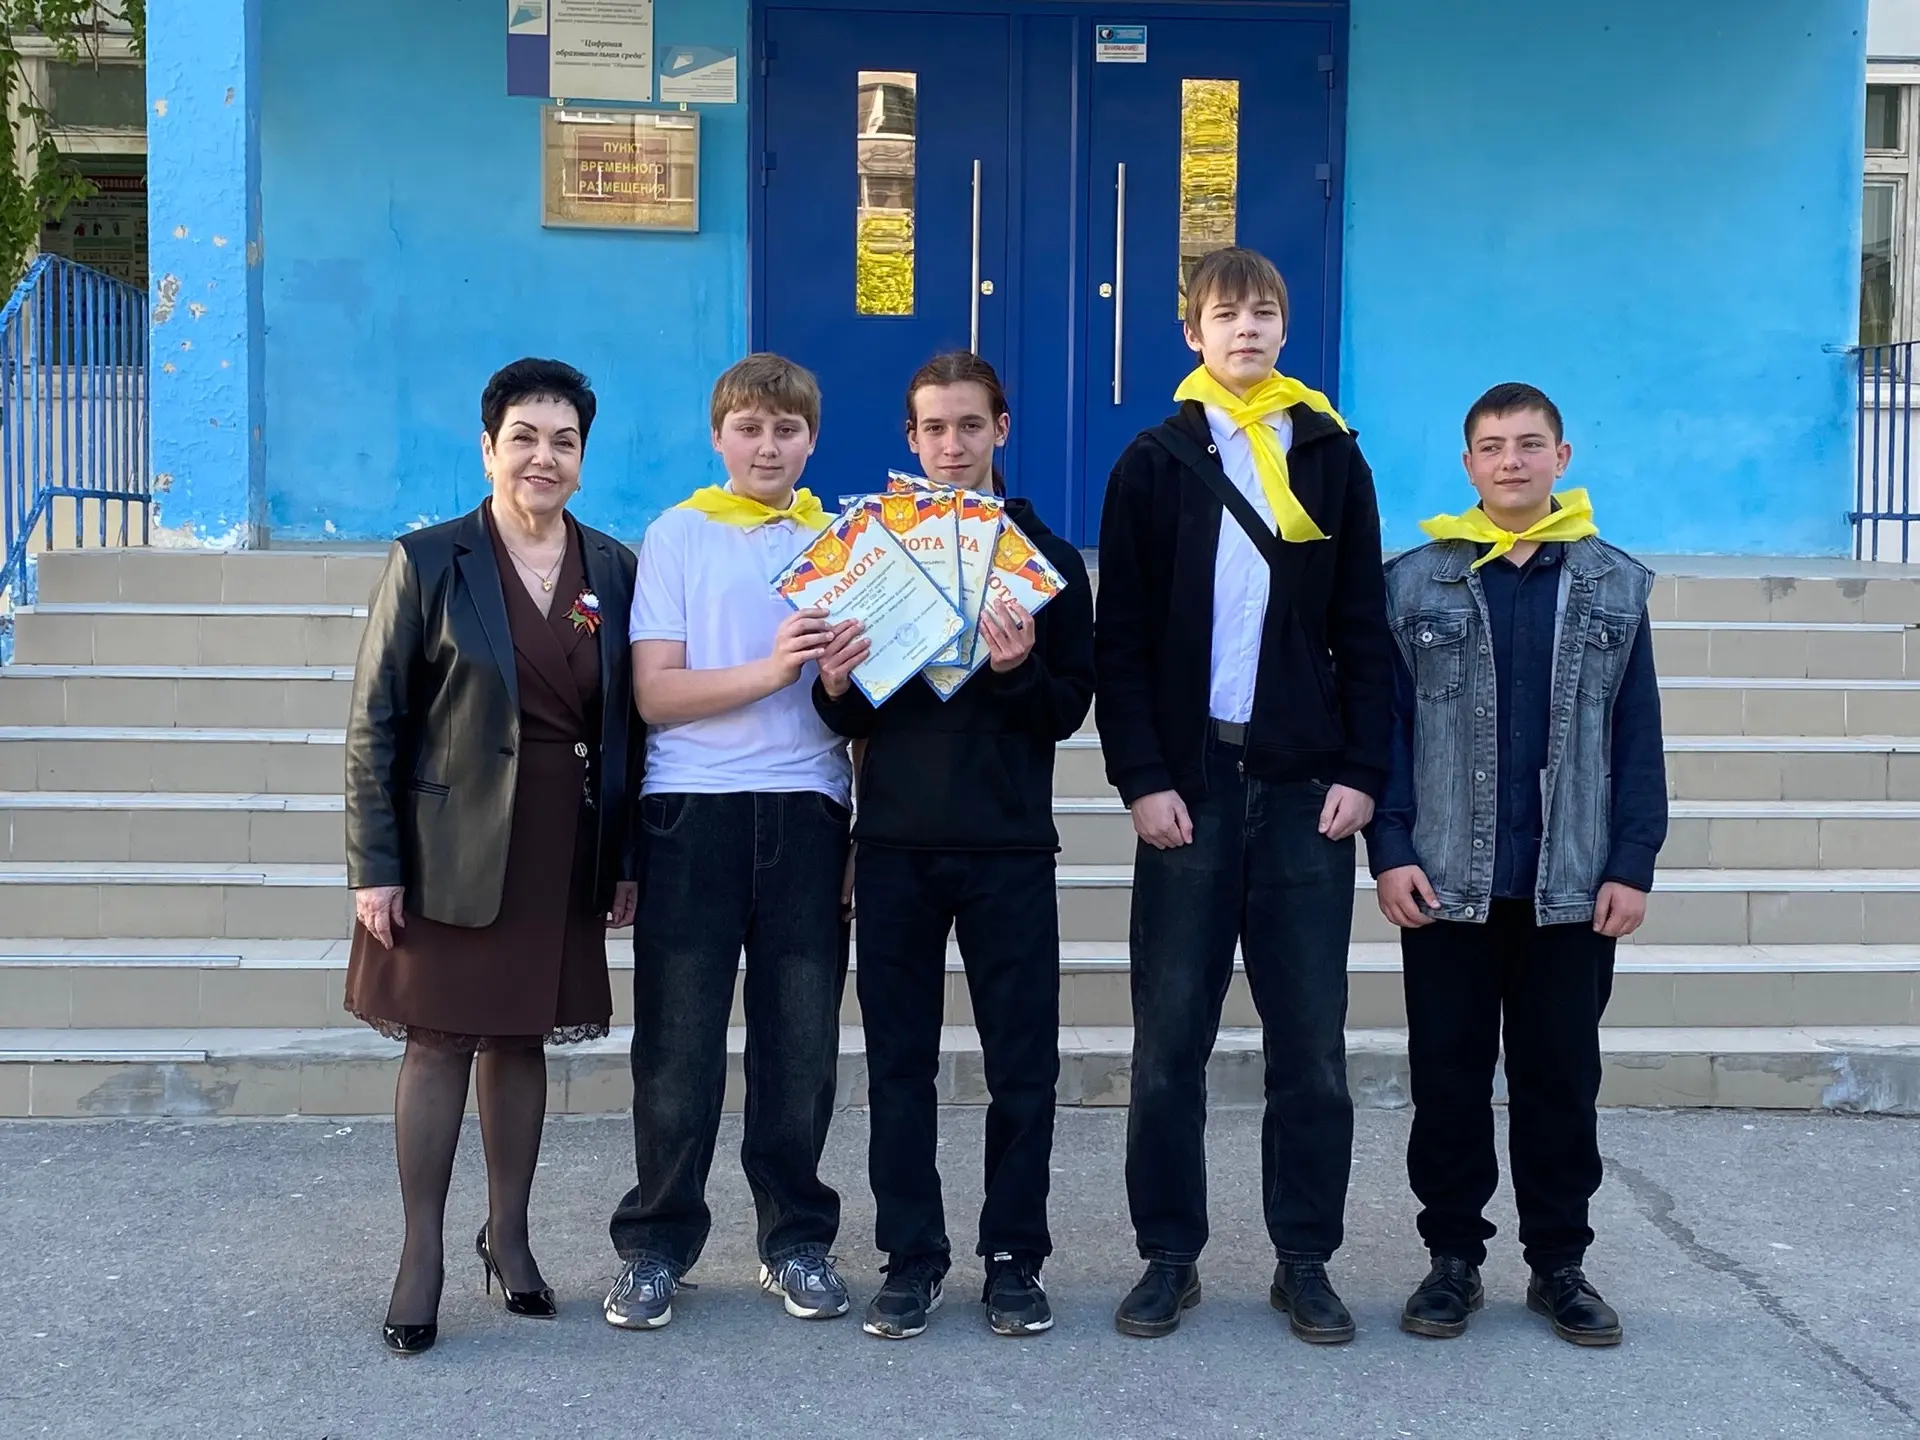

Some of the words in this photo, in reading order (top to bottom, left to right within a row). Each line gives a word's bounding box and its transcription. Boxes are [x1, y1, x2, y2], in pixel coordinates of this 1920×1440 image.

[603, 142, 641, 154] ПУНКТ
[580, 161, 664, 175] ВРЕМЕННОГО
[579, 180, 666, 194] РАЗМЕЩЕНИЯ
[813, 546, 887, 609] ГРАМОТА
